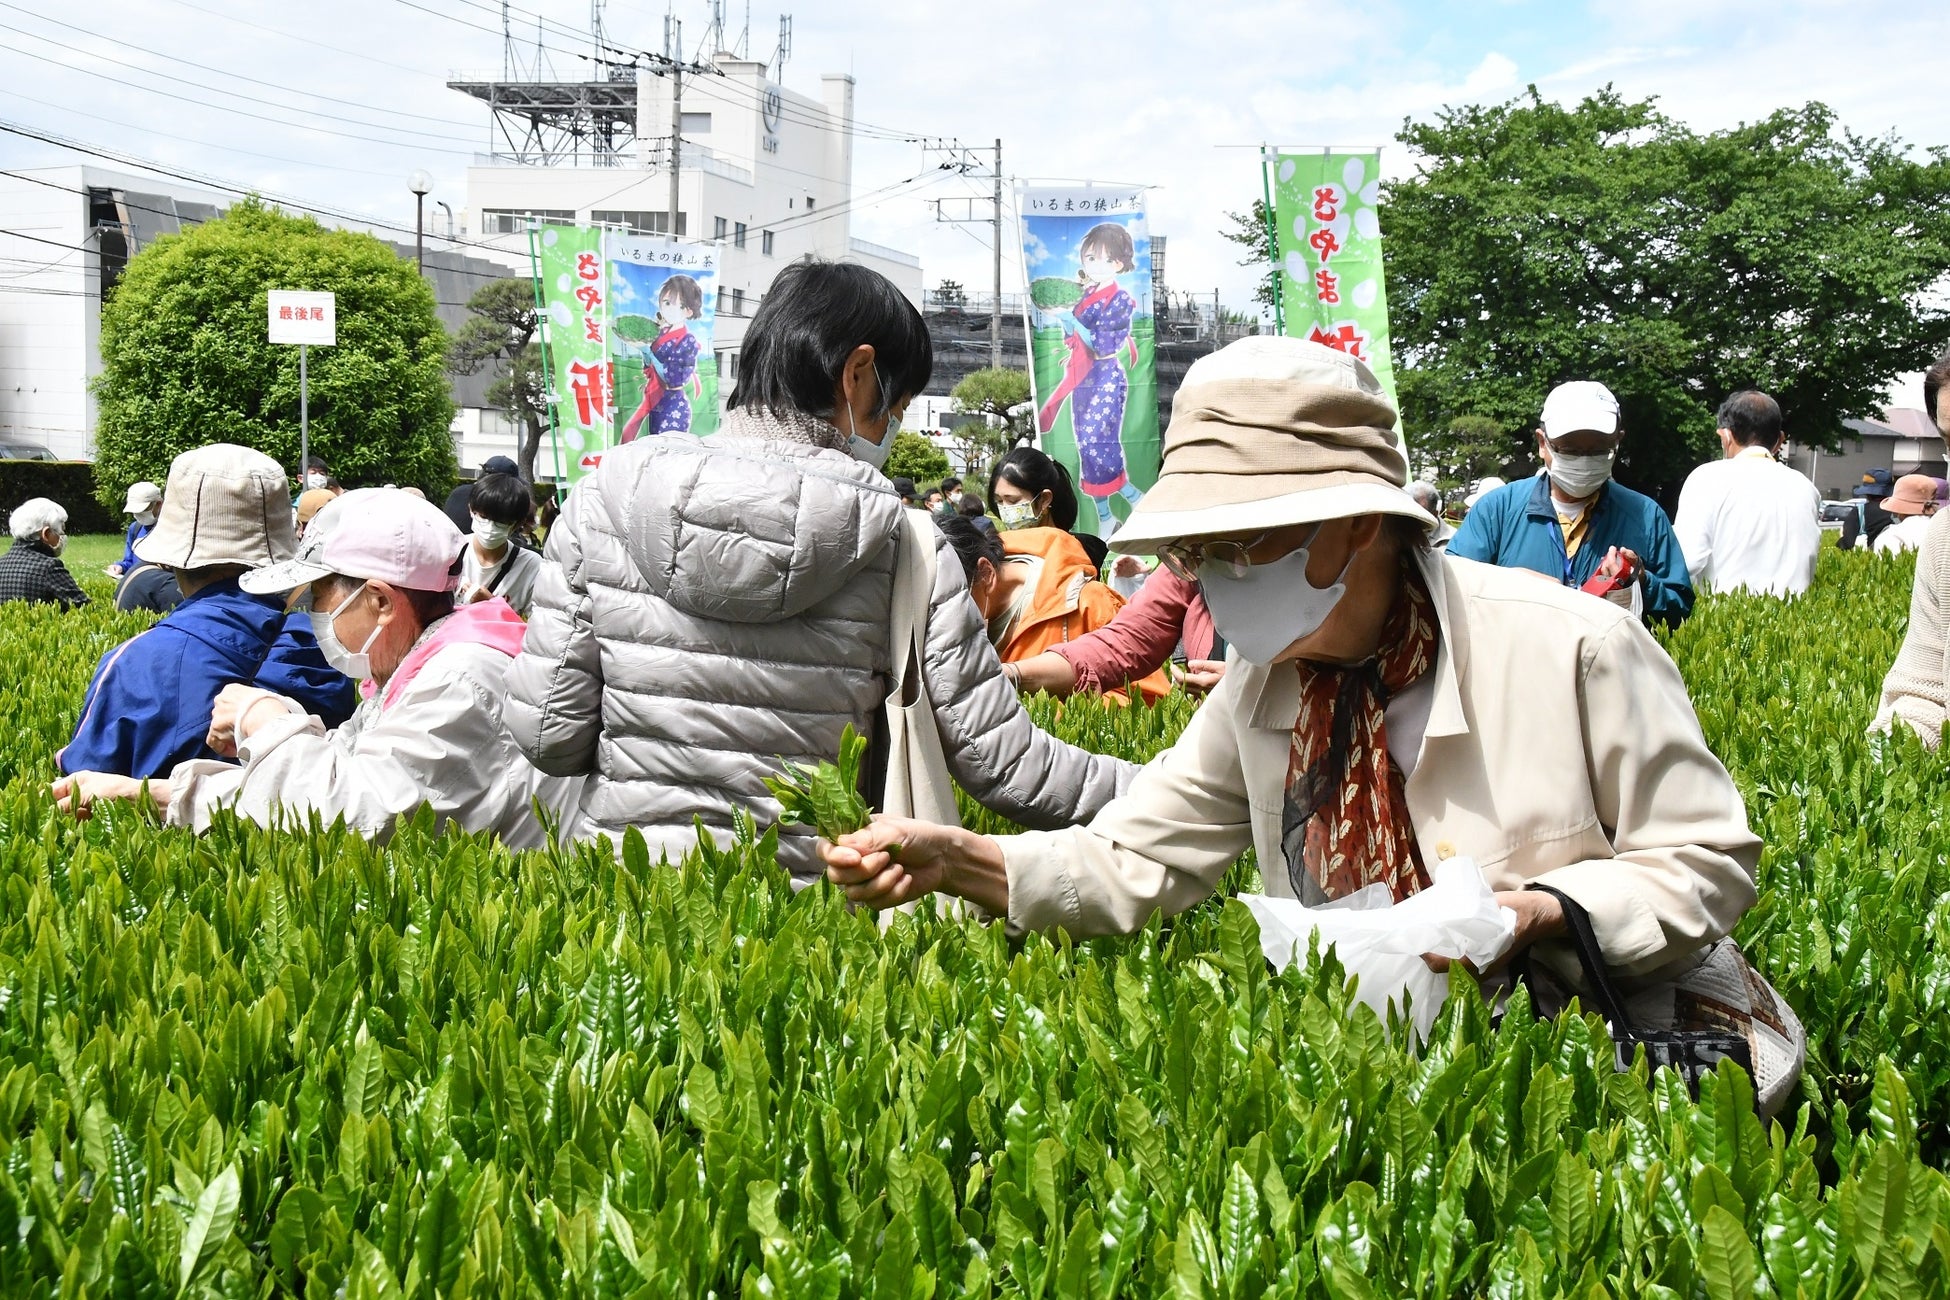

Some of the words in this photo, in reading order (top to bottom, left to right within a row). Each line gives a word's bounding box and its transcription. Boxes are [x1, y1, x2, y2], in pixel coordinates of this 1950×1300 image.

[1032, 195, 1141, 212] いるまの狭山茶
[621, 247, 713, 268] いるまの狭山茶
[279, 306, 324, 321] 最後尾
